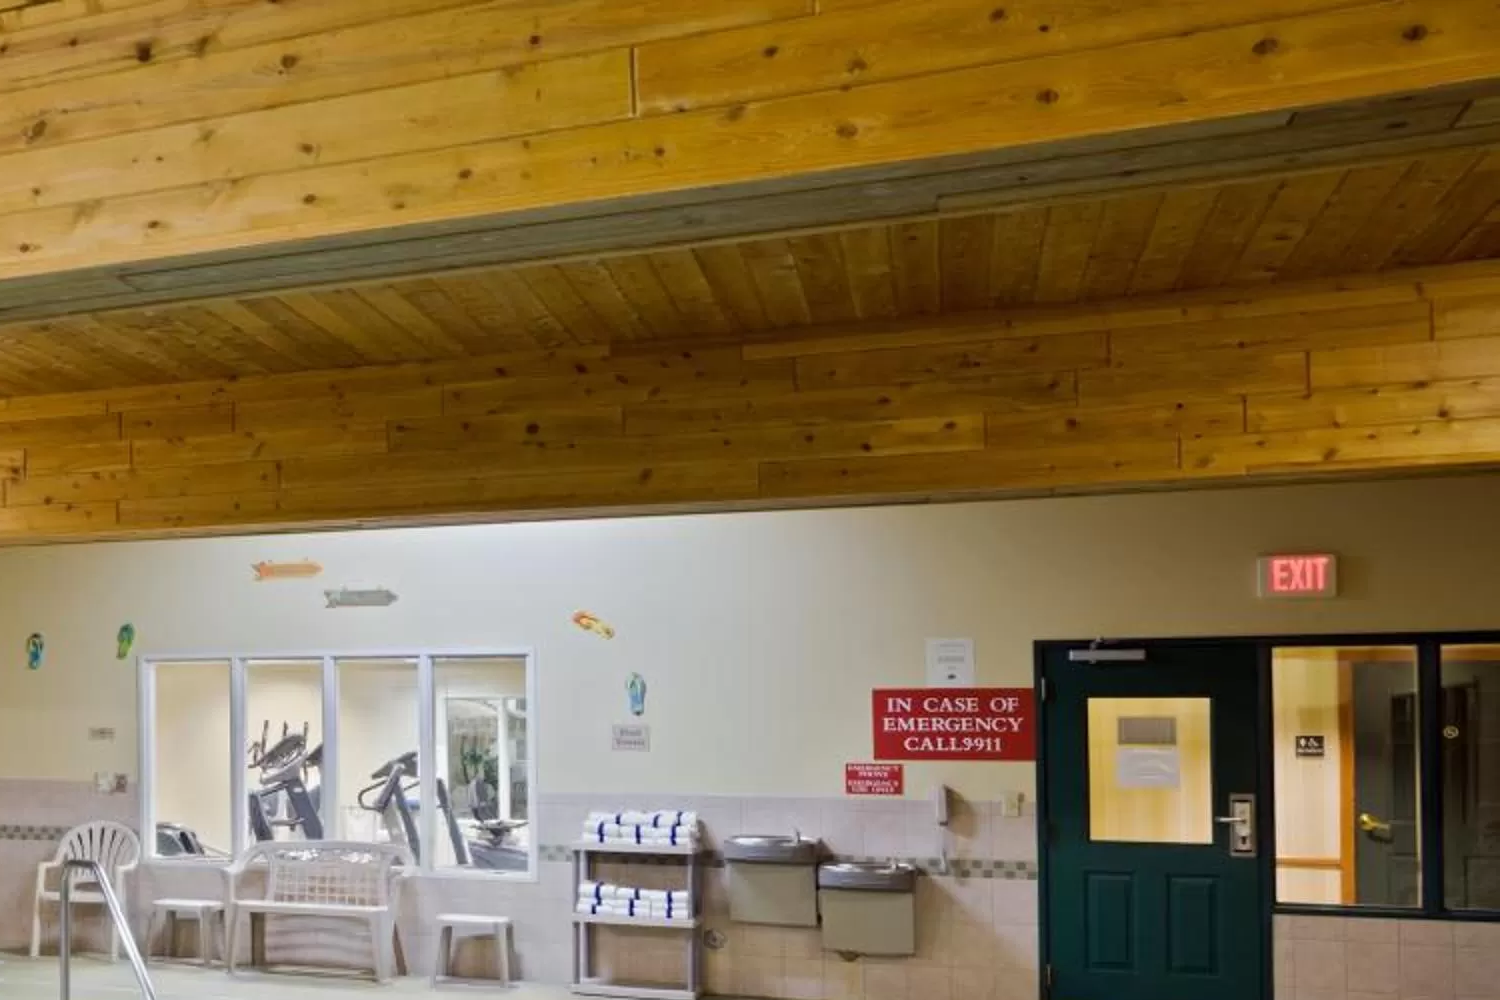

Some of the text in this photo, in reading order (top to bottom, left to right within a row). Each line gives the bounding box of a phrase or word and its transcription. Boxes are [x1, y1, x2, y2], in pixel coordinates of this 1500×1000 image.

[1272, 557, 1329, 592] EXIT
[887, 698, 1020, 713] IN CASE OF
[883, 717, 1024, 733] EMERGENCY
